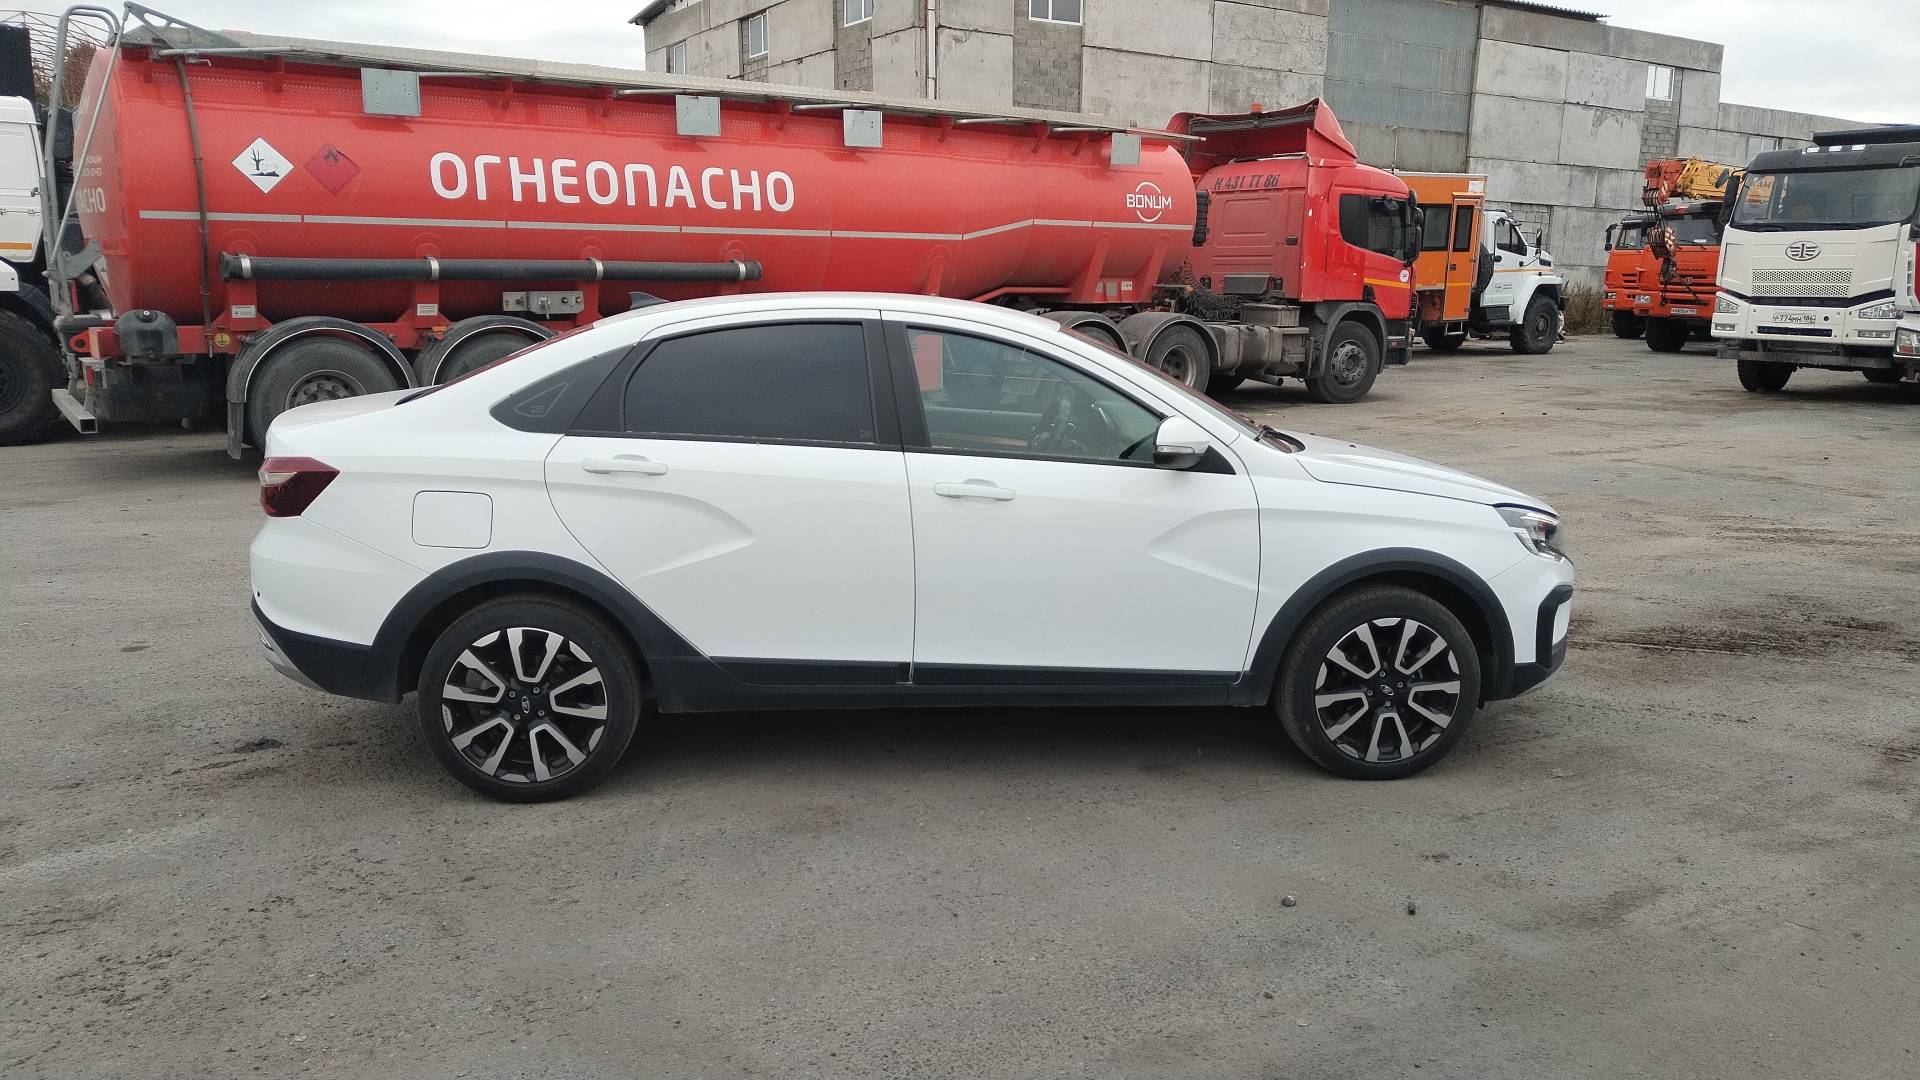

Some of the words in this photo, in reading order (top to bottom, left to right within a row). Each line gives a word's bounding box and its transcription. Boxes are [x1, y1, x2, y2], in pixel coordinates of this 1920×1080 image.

[430, 151, 795, 212] ОГНЕОПАСНО
[1224, 175, 1246, 190] 431
[1264, 174, 1280, 188] 86
[1126, 193, 1172, 209] BONUM
